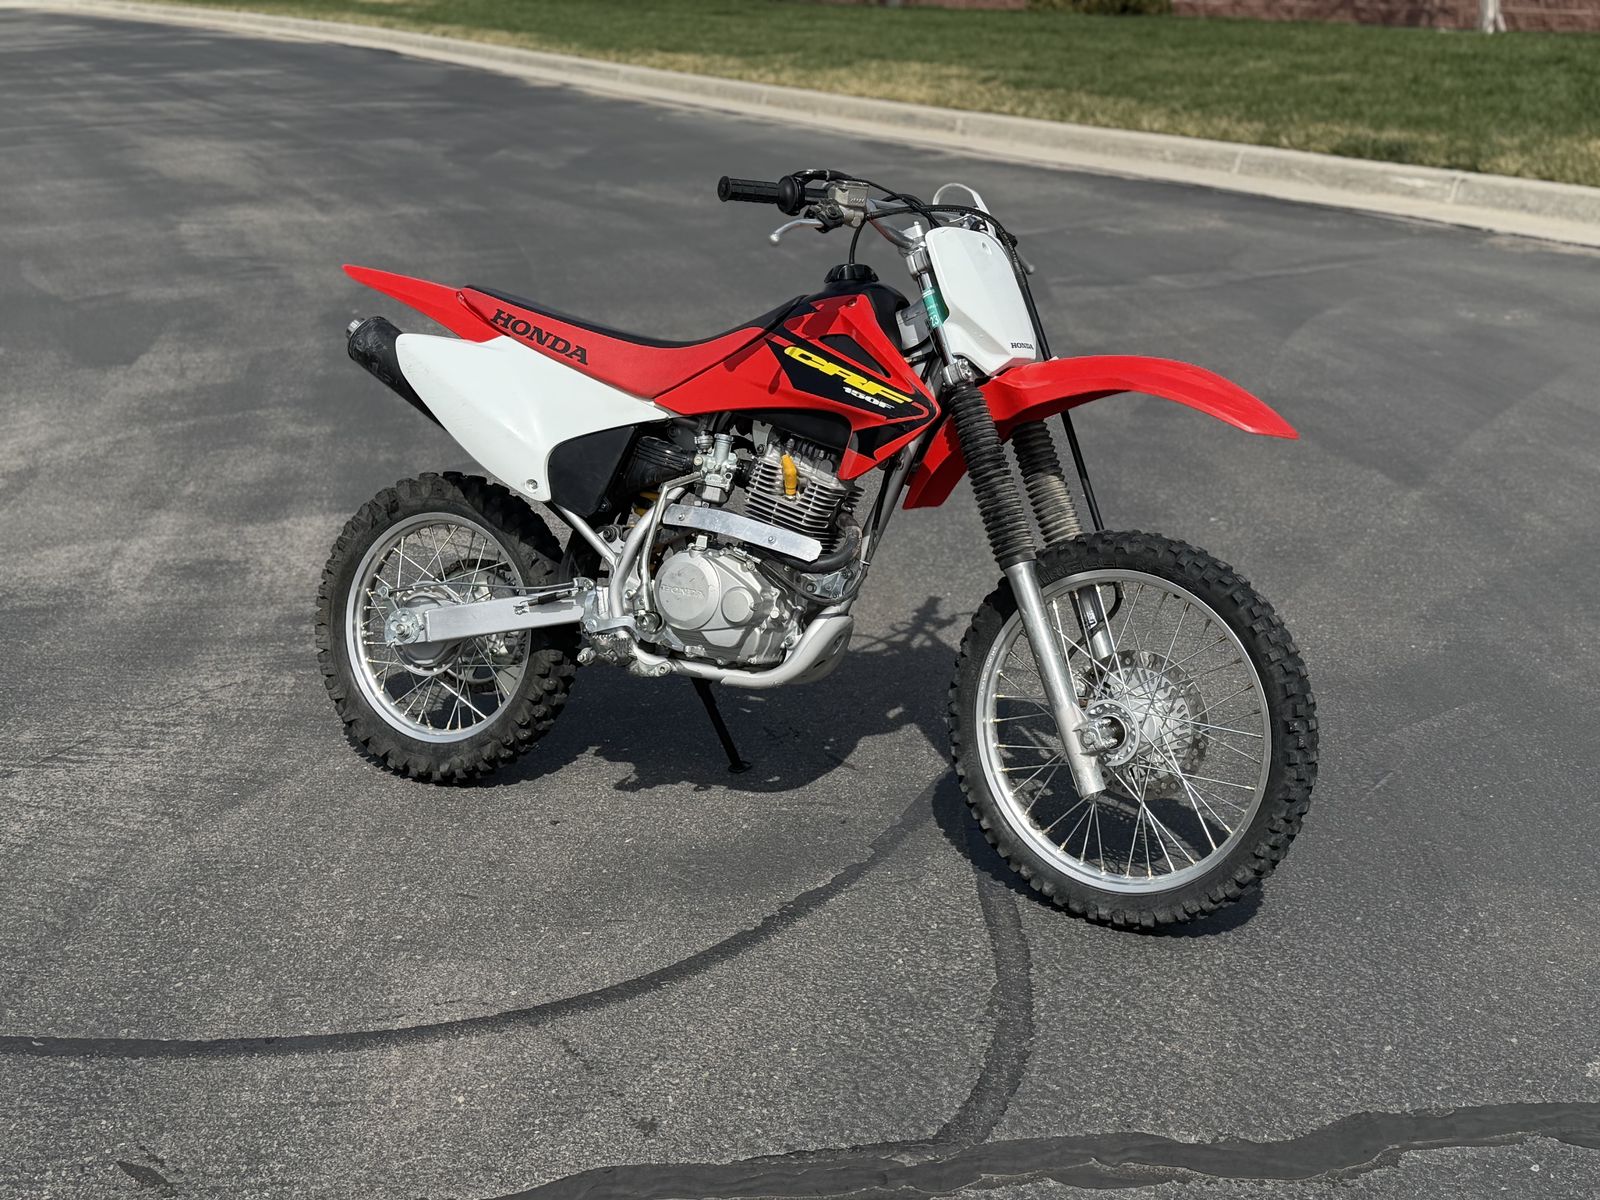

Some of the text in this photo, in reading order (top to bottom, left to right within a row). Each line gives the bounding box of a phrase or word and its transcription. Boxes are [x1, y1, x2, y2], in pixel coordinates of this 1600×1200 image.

[490, 309, 588, 365] HONDA
[1010, 342, 1035, 350] HONDA
[784, 346, 913, 404] CRF
